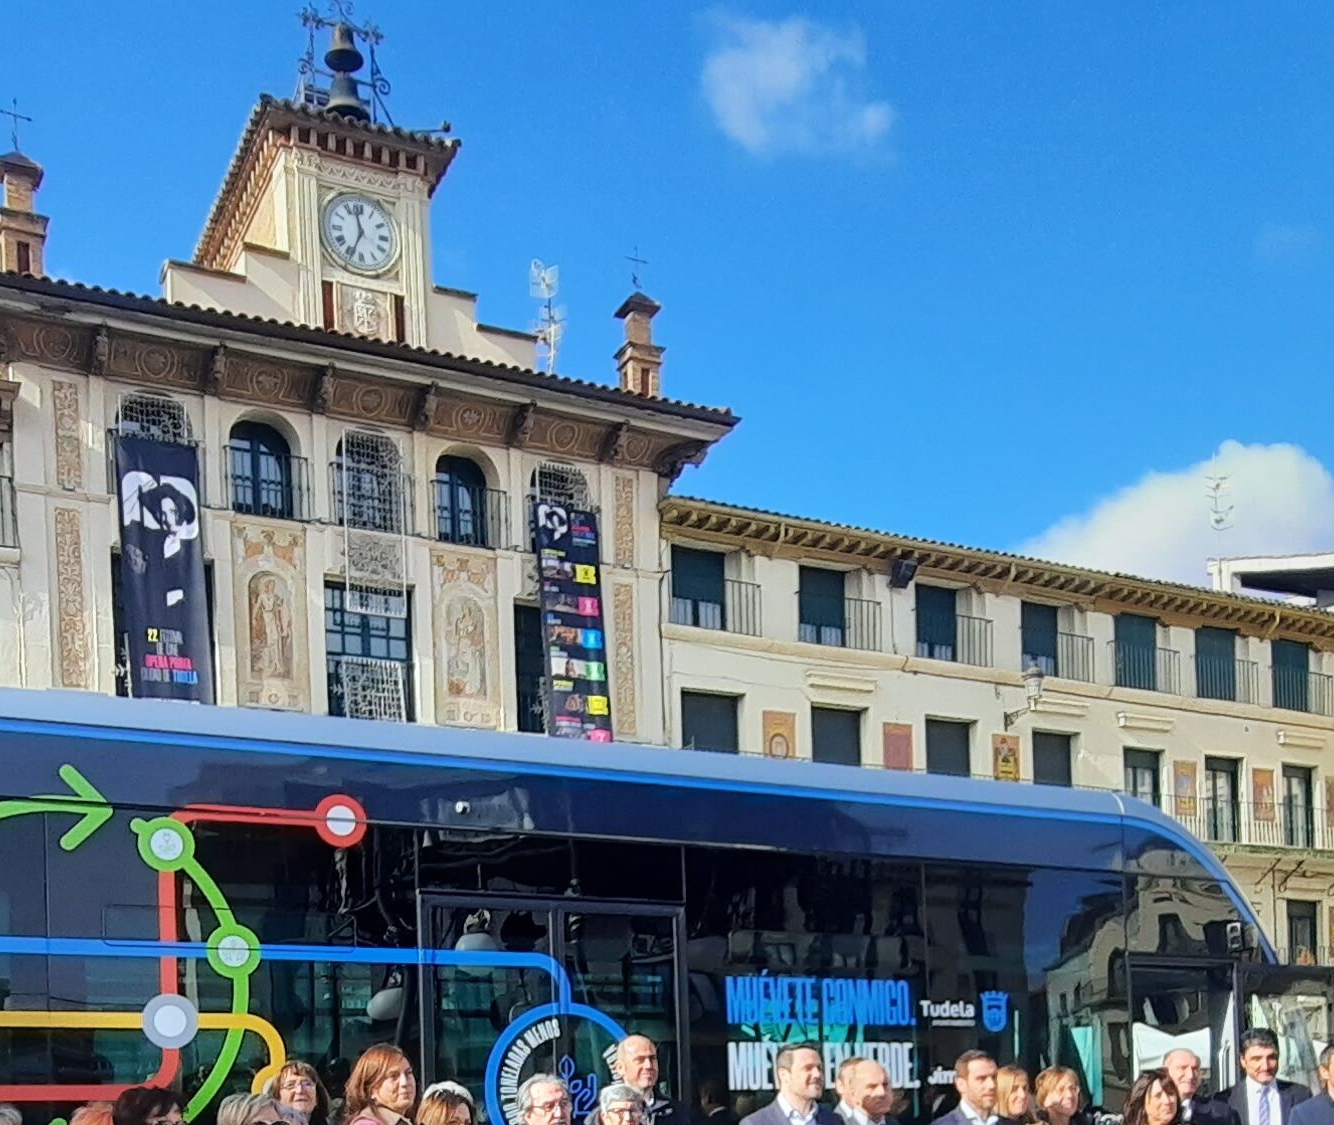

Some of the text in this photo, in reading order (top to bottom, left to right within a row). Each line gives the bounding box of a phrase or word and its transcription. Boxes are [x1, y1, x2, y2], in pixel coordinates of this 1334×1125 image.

[725, 969, 916, 1026] MUÉVETE CONMIGO.
[919, 1000, 975, 1019] Tudela
[500, 1039, 532, 1101] TONELADAS
[523, 1018, 561, 1049] MENOS
